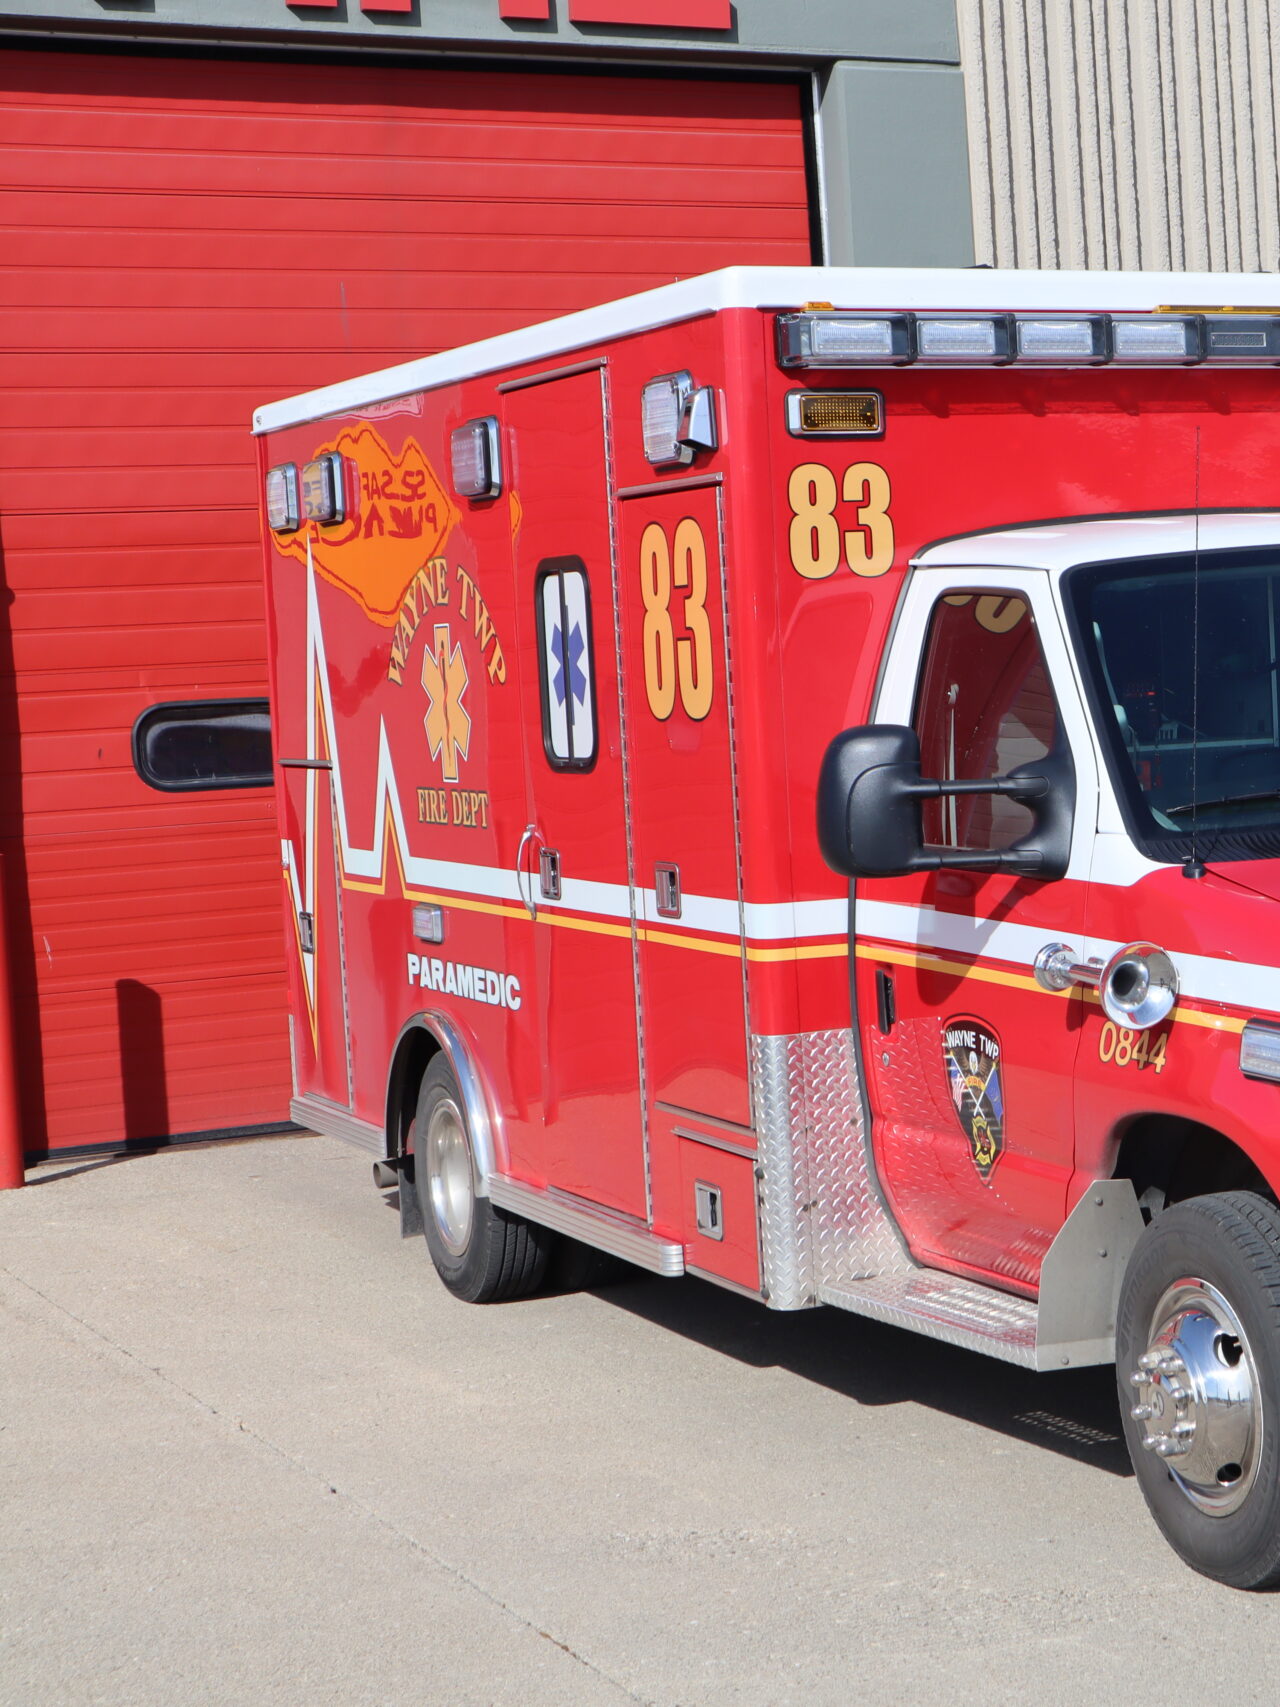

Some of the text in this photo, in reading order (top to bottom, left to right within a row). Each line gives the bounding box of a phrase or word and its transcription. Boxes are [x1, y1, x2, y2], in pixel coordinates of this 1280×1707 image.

[787, 461, 895, 579] 83
[387, 556, 506, 687] WAYNE TWP
[640, 516, 714, 722] 83
[416, 787, 489, 829] FIRE DEPT
[406, 952, 522, 1011] PARAMEDIC
[945, 1029, 999, 1060] WAYNE TWP
[1098, 1020, 1168, 1074] 0844
